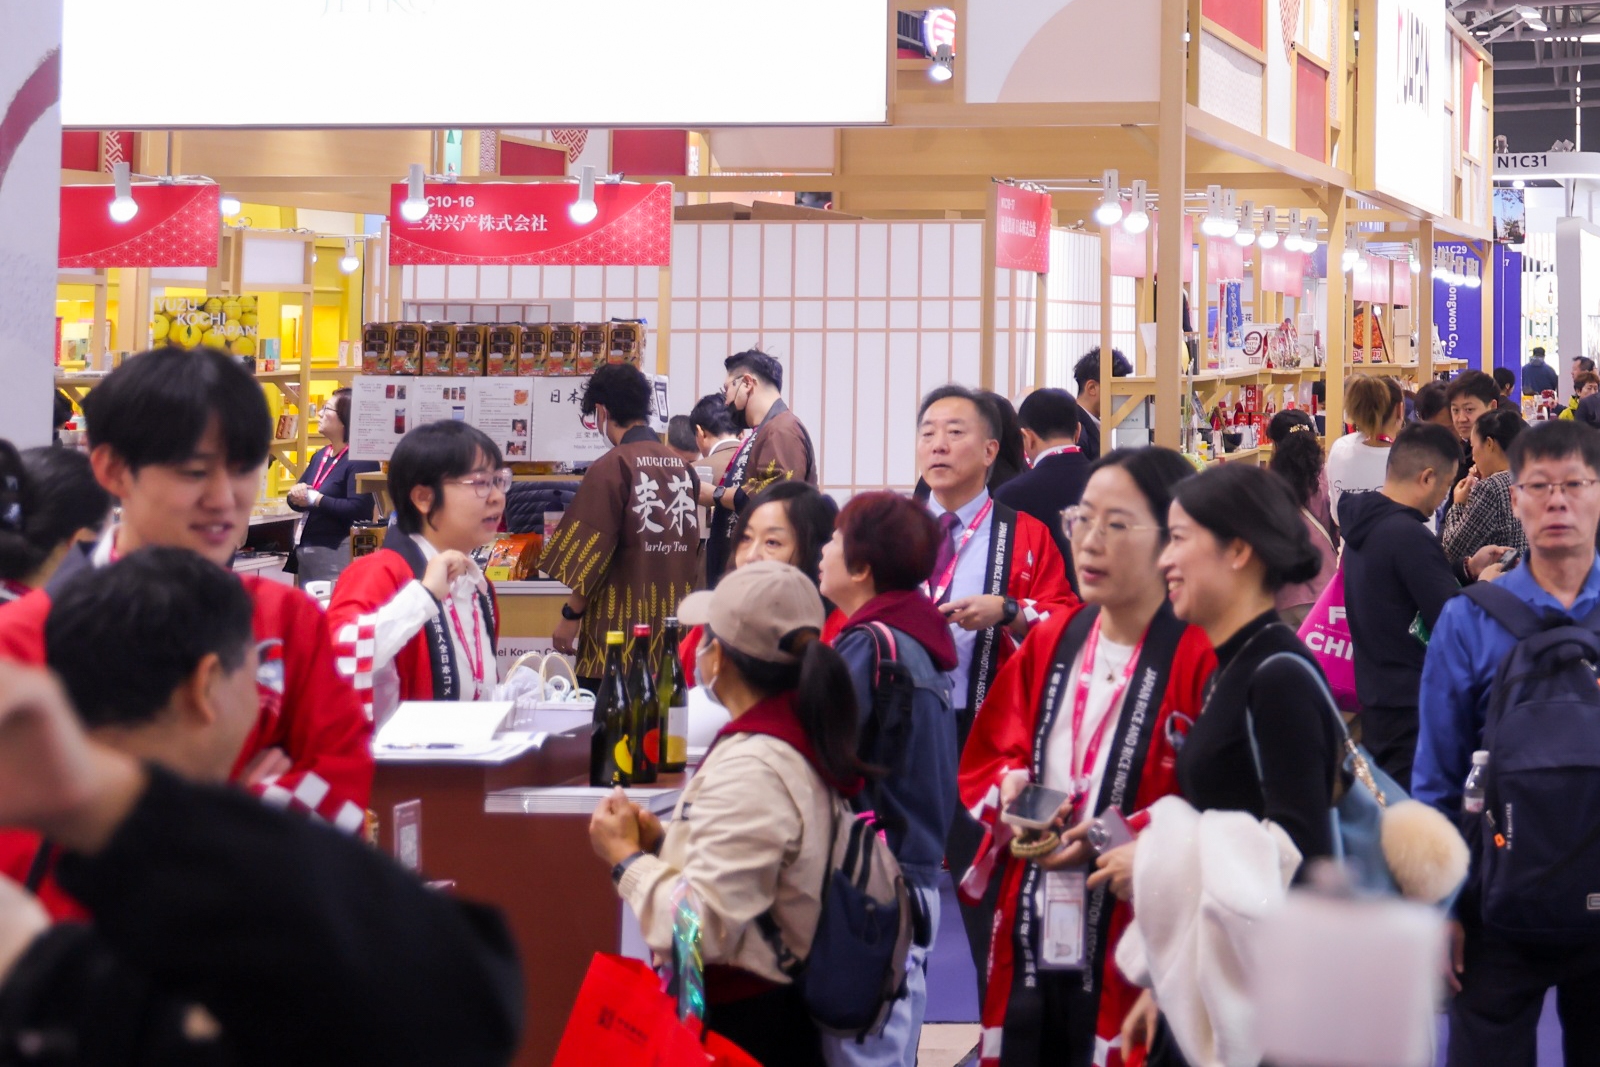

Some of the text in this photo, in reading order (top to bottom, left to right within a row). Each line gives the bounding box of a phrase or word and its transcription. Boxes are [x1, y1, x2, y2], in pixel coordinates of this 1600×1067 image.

[1497, 155, 1548, 168] N1C31
[157, 298, 198, 311] YUZU
[1446, 282, 1457, 332] ongwon
[177, 312, 226, 325] KOCHI
[212, 325, 257, 336] JAPAN
[636, 456, 684, 468] MUGICHA
[645, 540, 688, 552] arley Tea
[1136, 666, 1159, 699] JAPAN
[1130, 700, 1148, 724] RICE
[1123, 724, 1141, 746] AND
[1116, 746, 1135, 770] RICE
